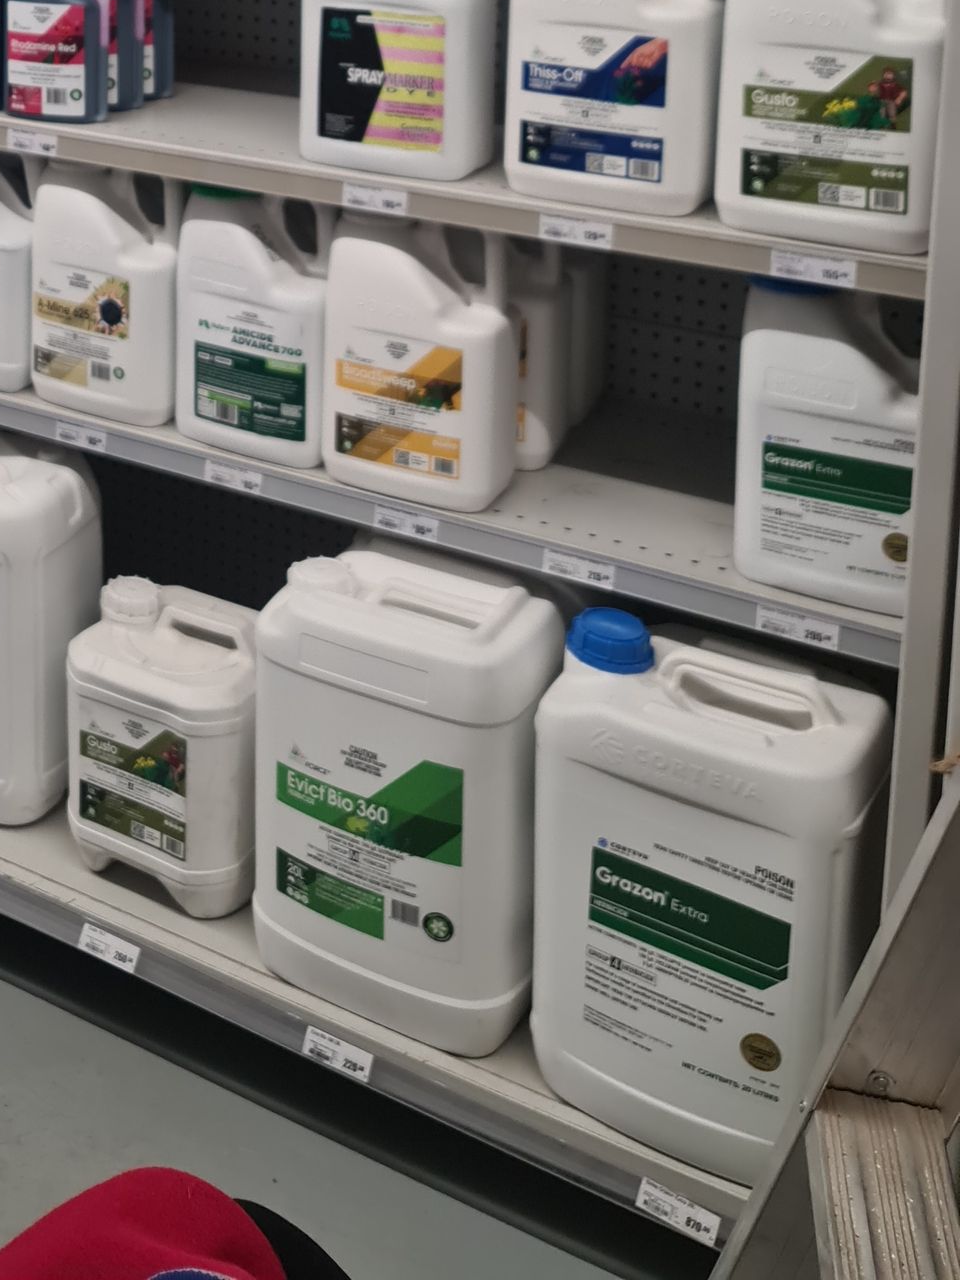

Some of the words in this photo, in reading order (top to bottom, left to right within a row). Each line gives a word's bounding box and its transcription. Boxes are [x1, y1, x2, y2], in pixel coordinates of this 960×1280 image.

[58, 41, 77, 54] Red
[346, 67, 385, 86] SPRAY
[528, 63, 585, 83] Thiss-Off
[751, 88, 798, 108] Gusto
[231, 326, 274, 343] AMICIDE
[231, 334, 280, 354] ADVANCE
[341, 360, 417, 393] BroadSweep
[764, 451, 814, 471] Grazon
[86, 734, 118, 755] Gusto
[287, 770, 327, 802] Evict
[327, 788, 354, 813] Bio
[356, 799, 389, 825] 360
[753, 864, 796, 890] POISON
[595, 865, 665, 906] Grazon
[669, 897, 710, 924] Extra
